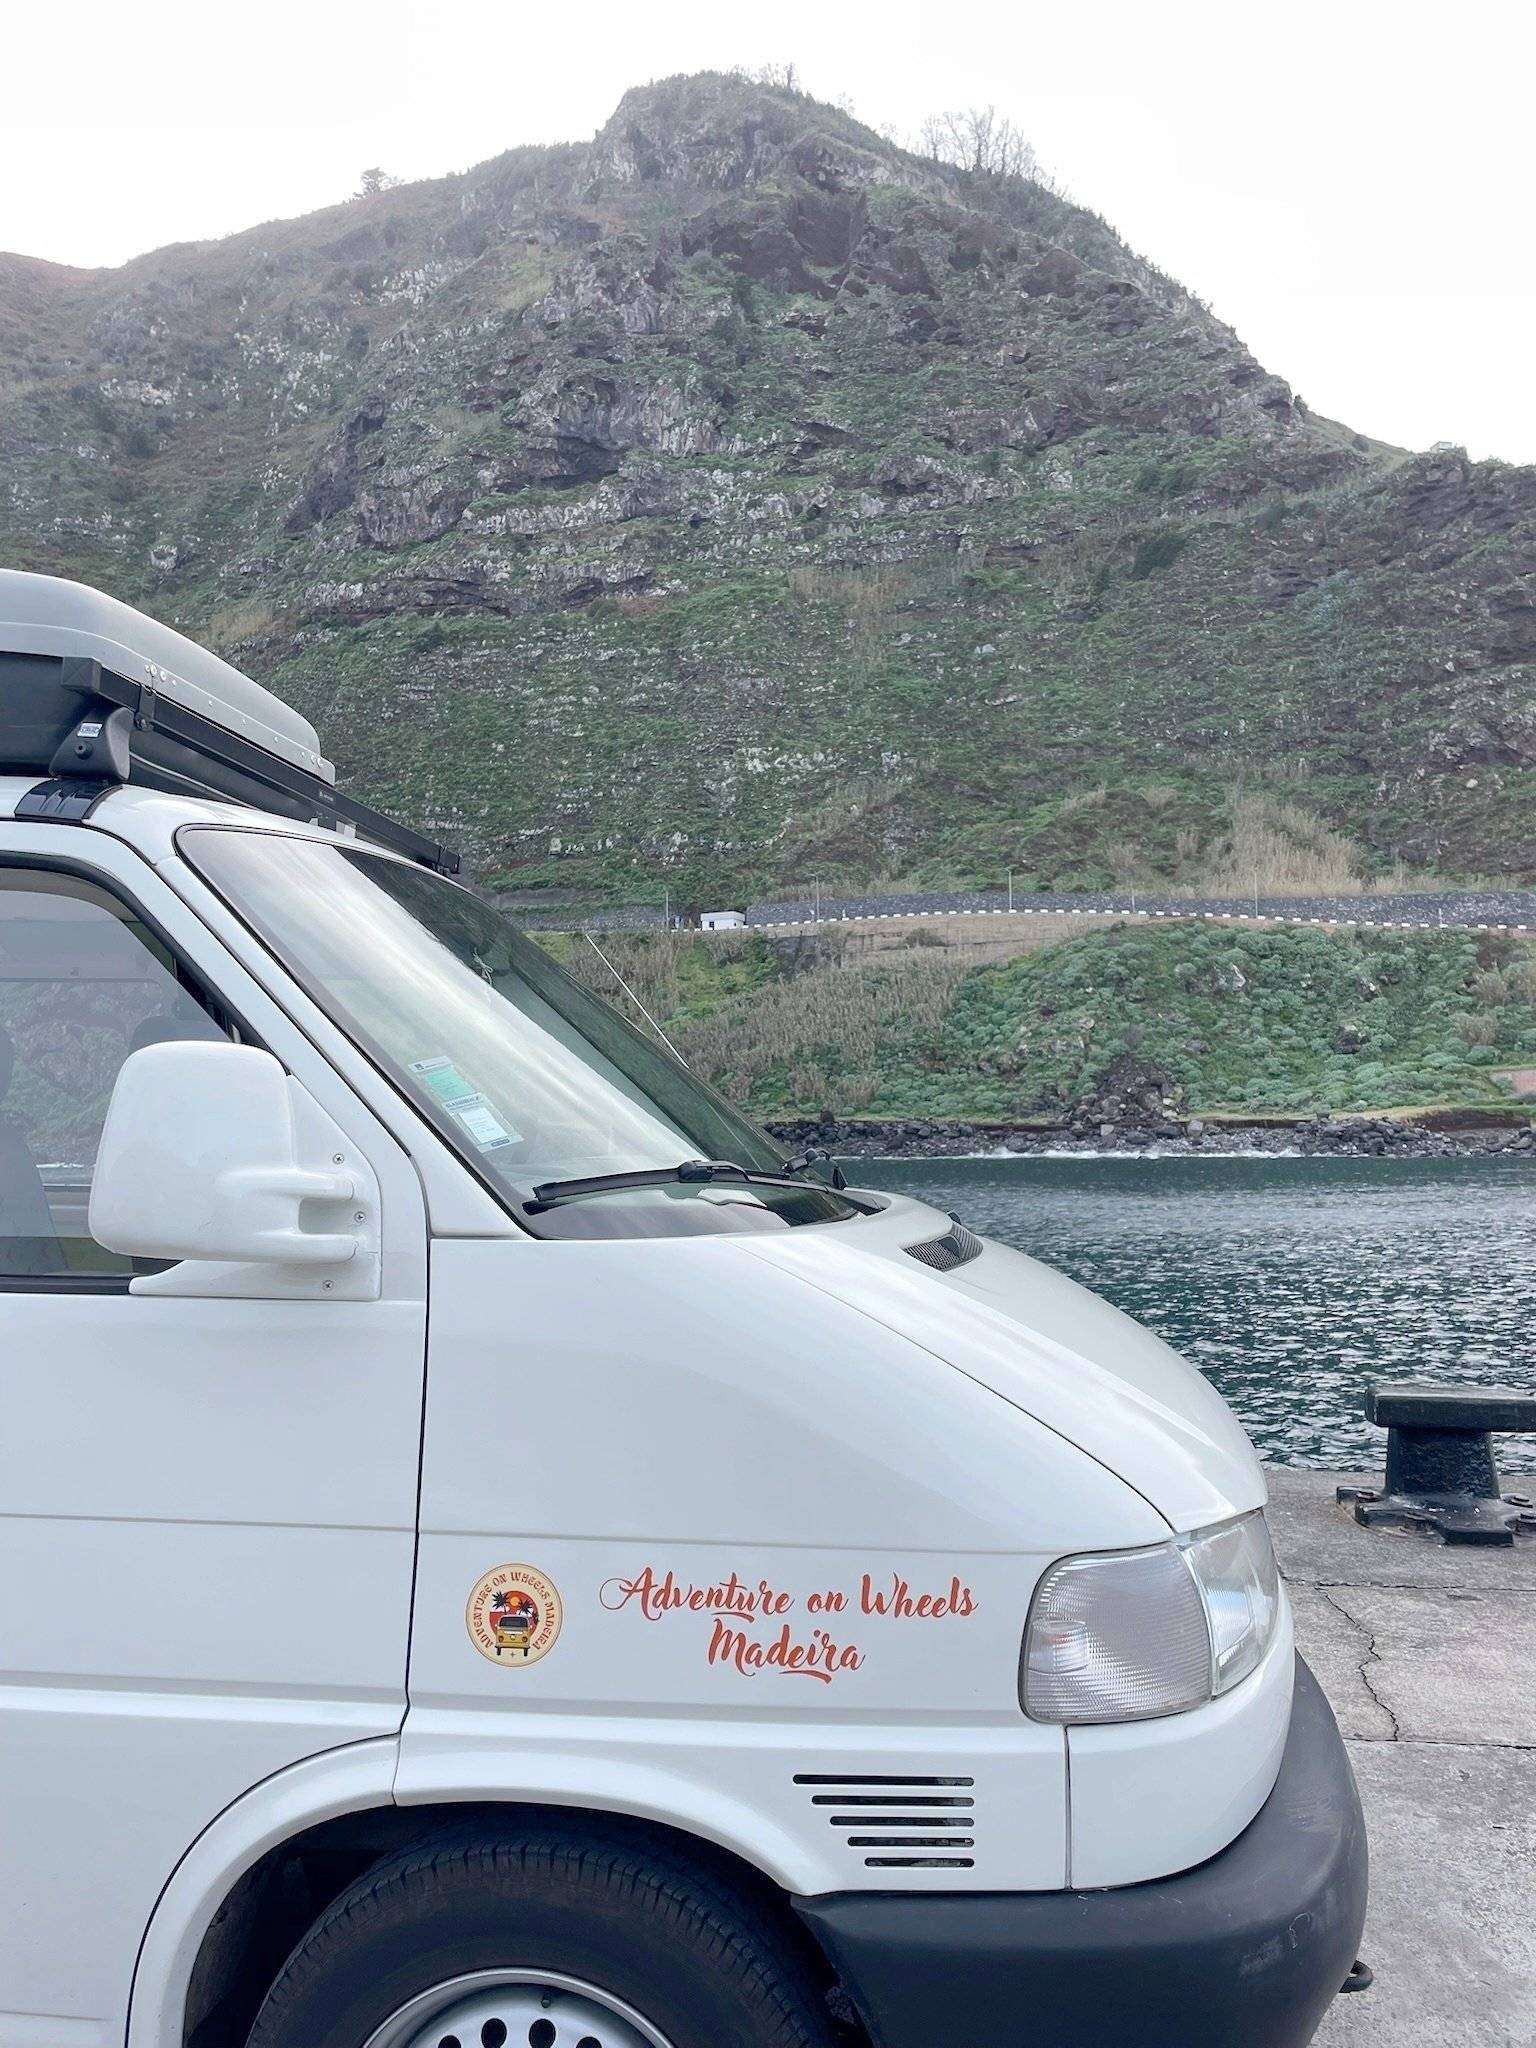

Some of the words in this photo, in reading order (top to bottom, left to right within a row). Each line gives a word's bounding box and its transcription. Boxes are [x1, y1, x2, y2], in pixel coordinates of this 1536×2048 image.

[473, 1584, 494, 1649] ADVENTURE
[493, 1573, 507, 1587] ON
[511, 1571, 550, 1600] WHEELS
[532, 1601, 555, 1650] MADEIRA
[600, 1567, 795, 1623] Adventure
[806, 1590, 849, 1614] on
[859, 1572, 979, 1619] Wheels
[708, 1618, 866, 1684] Madeira
